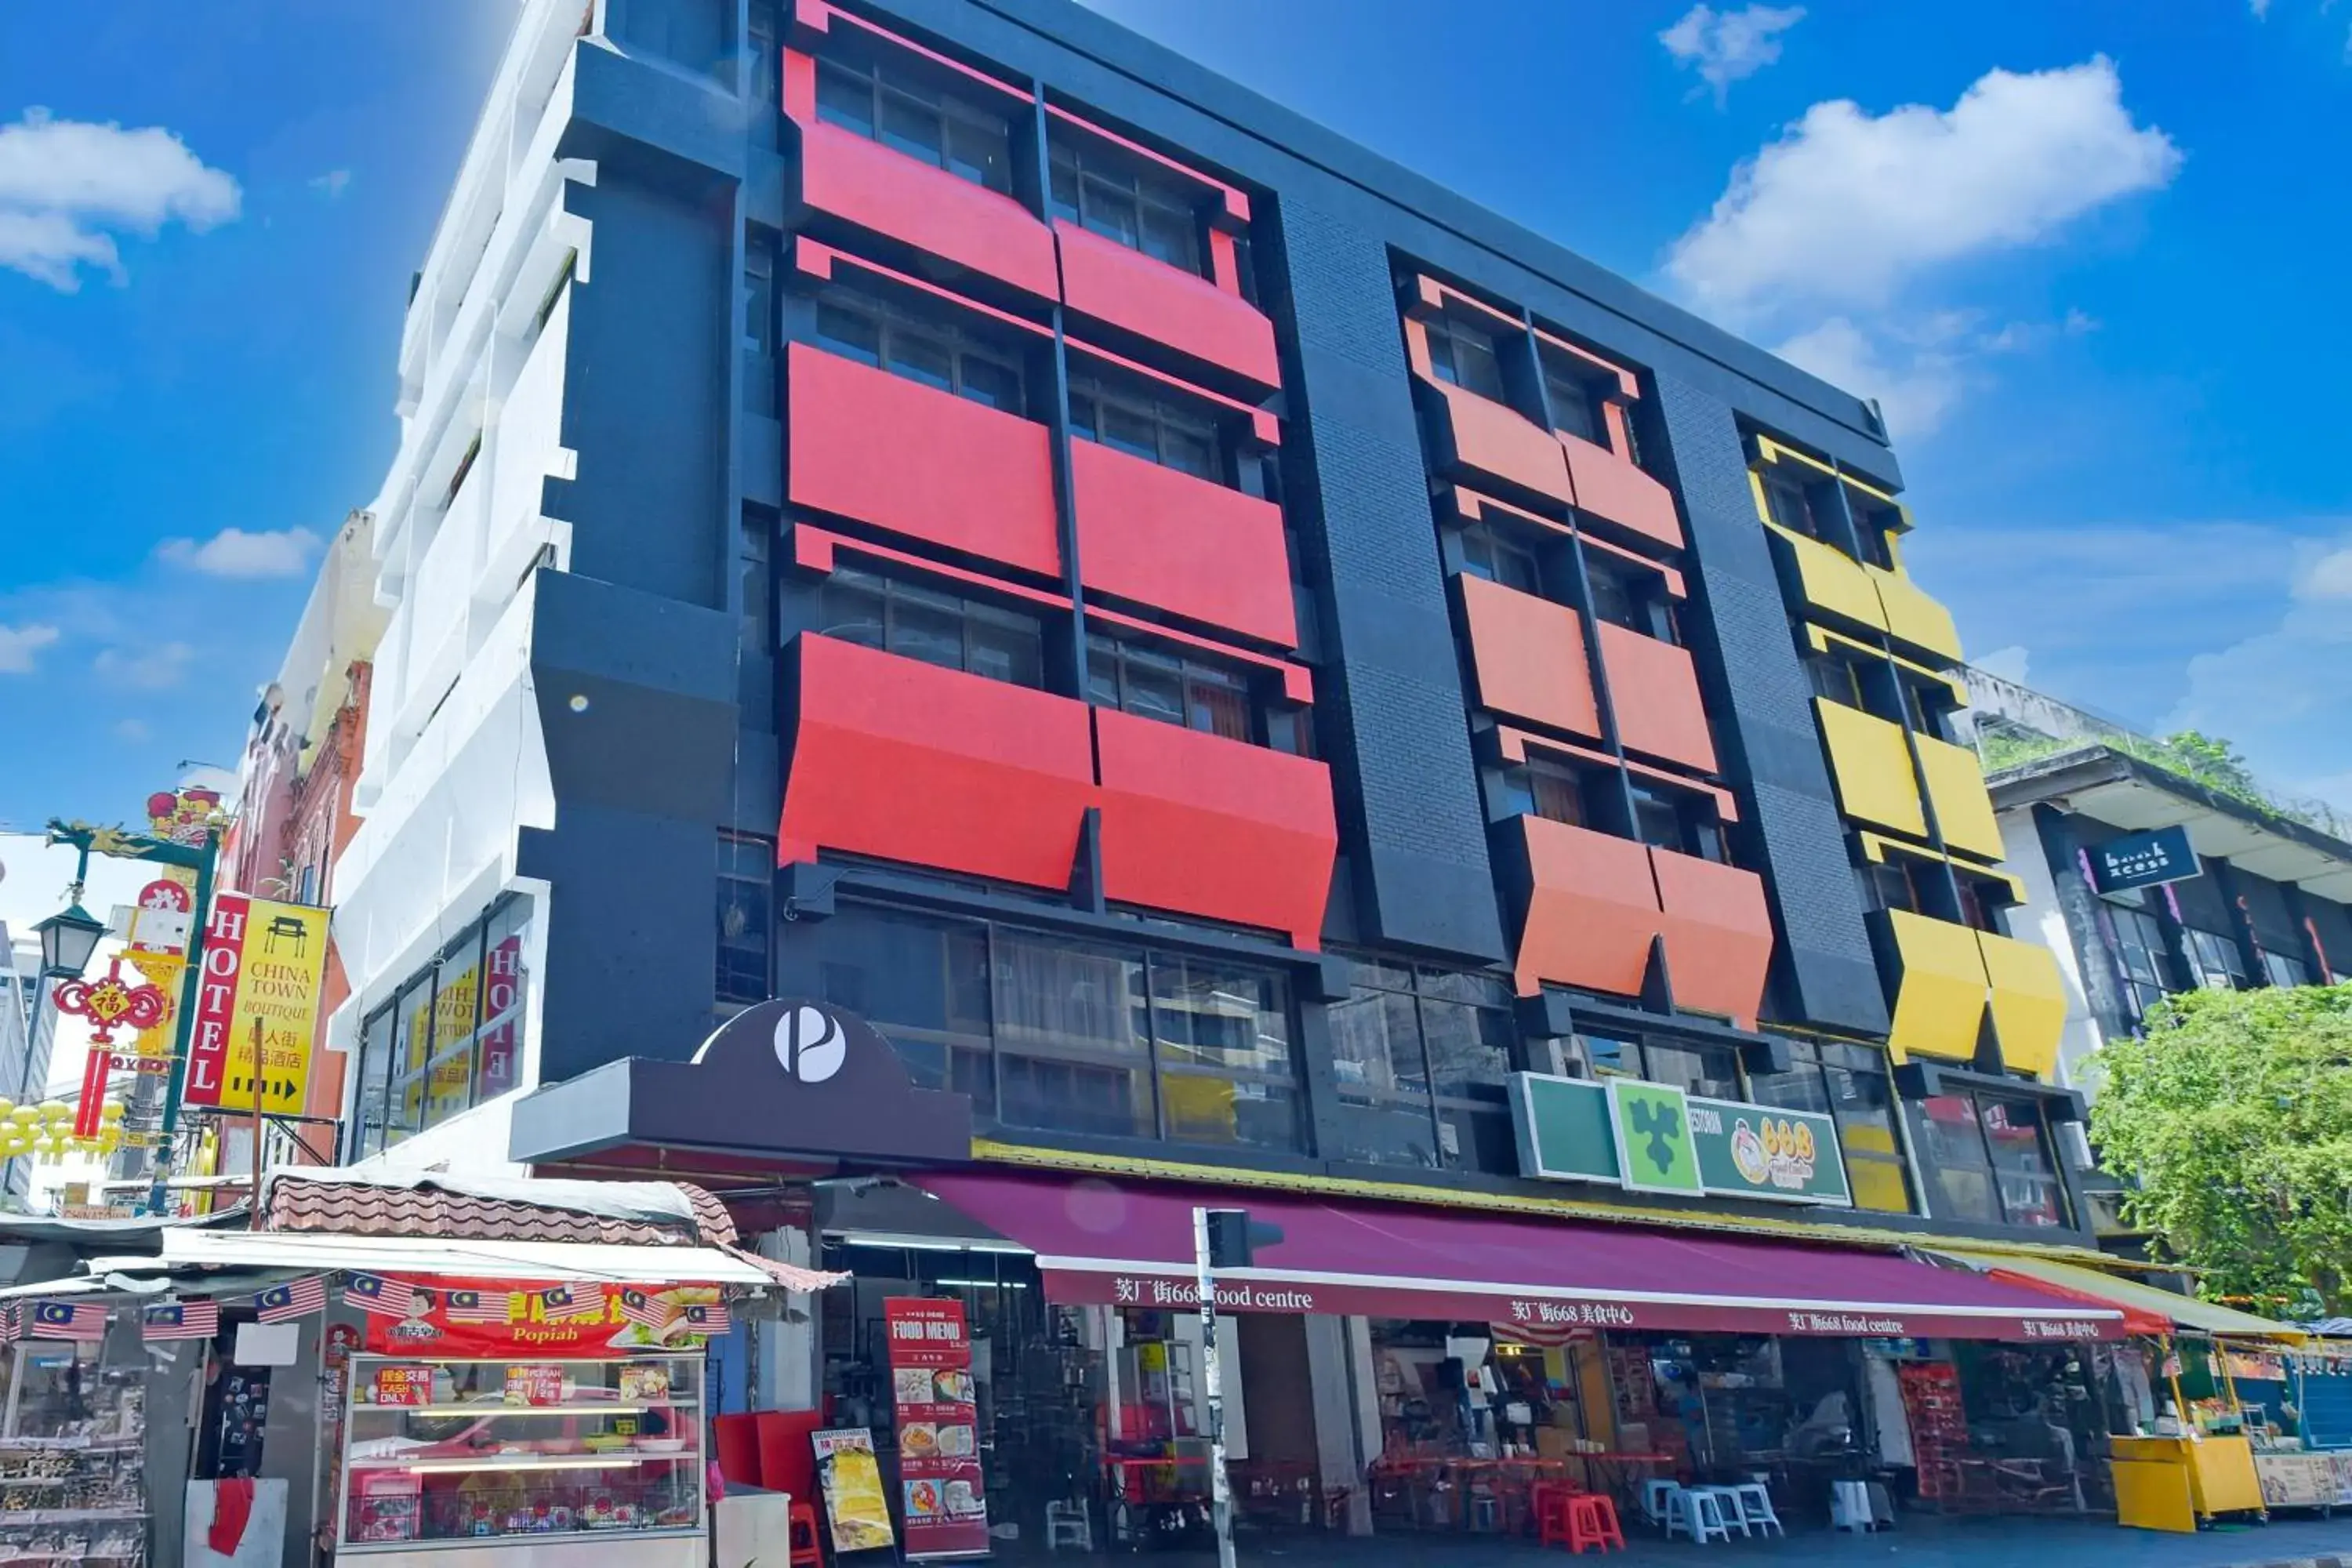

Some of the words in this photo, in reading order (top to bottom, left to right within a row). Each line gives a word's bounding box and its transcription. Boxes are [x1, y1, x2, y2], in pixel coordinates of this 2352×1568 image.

[250, 962, 312, 984] CHINA
[250, 979, 309, 1000] TOWN
[96, 993, 122, 1017] 福
[192, 910, 245, 1090] HOTEL
[243, 1000, 309, 1021] BOUTIQUE
[1761, 1116, 1815, 1163] 668
[1255, 1290, 1313, 1308] centre
[1581, 1304, 1634, 1324] 美食中心
[891, 1320, 924, 1340] FOOD
[926, 1321, 960, 1340] MENU
[1842, 1315, 1868, 1332] food
[1868, 1318, 1904, 1334] centre
[513, 1327, 579, 1344] Popiah
[380, 1393, 407, 1403] ONLY
[381, 1384, 409, 1393] CASH
